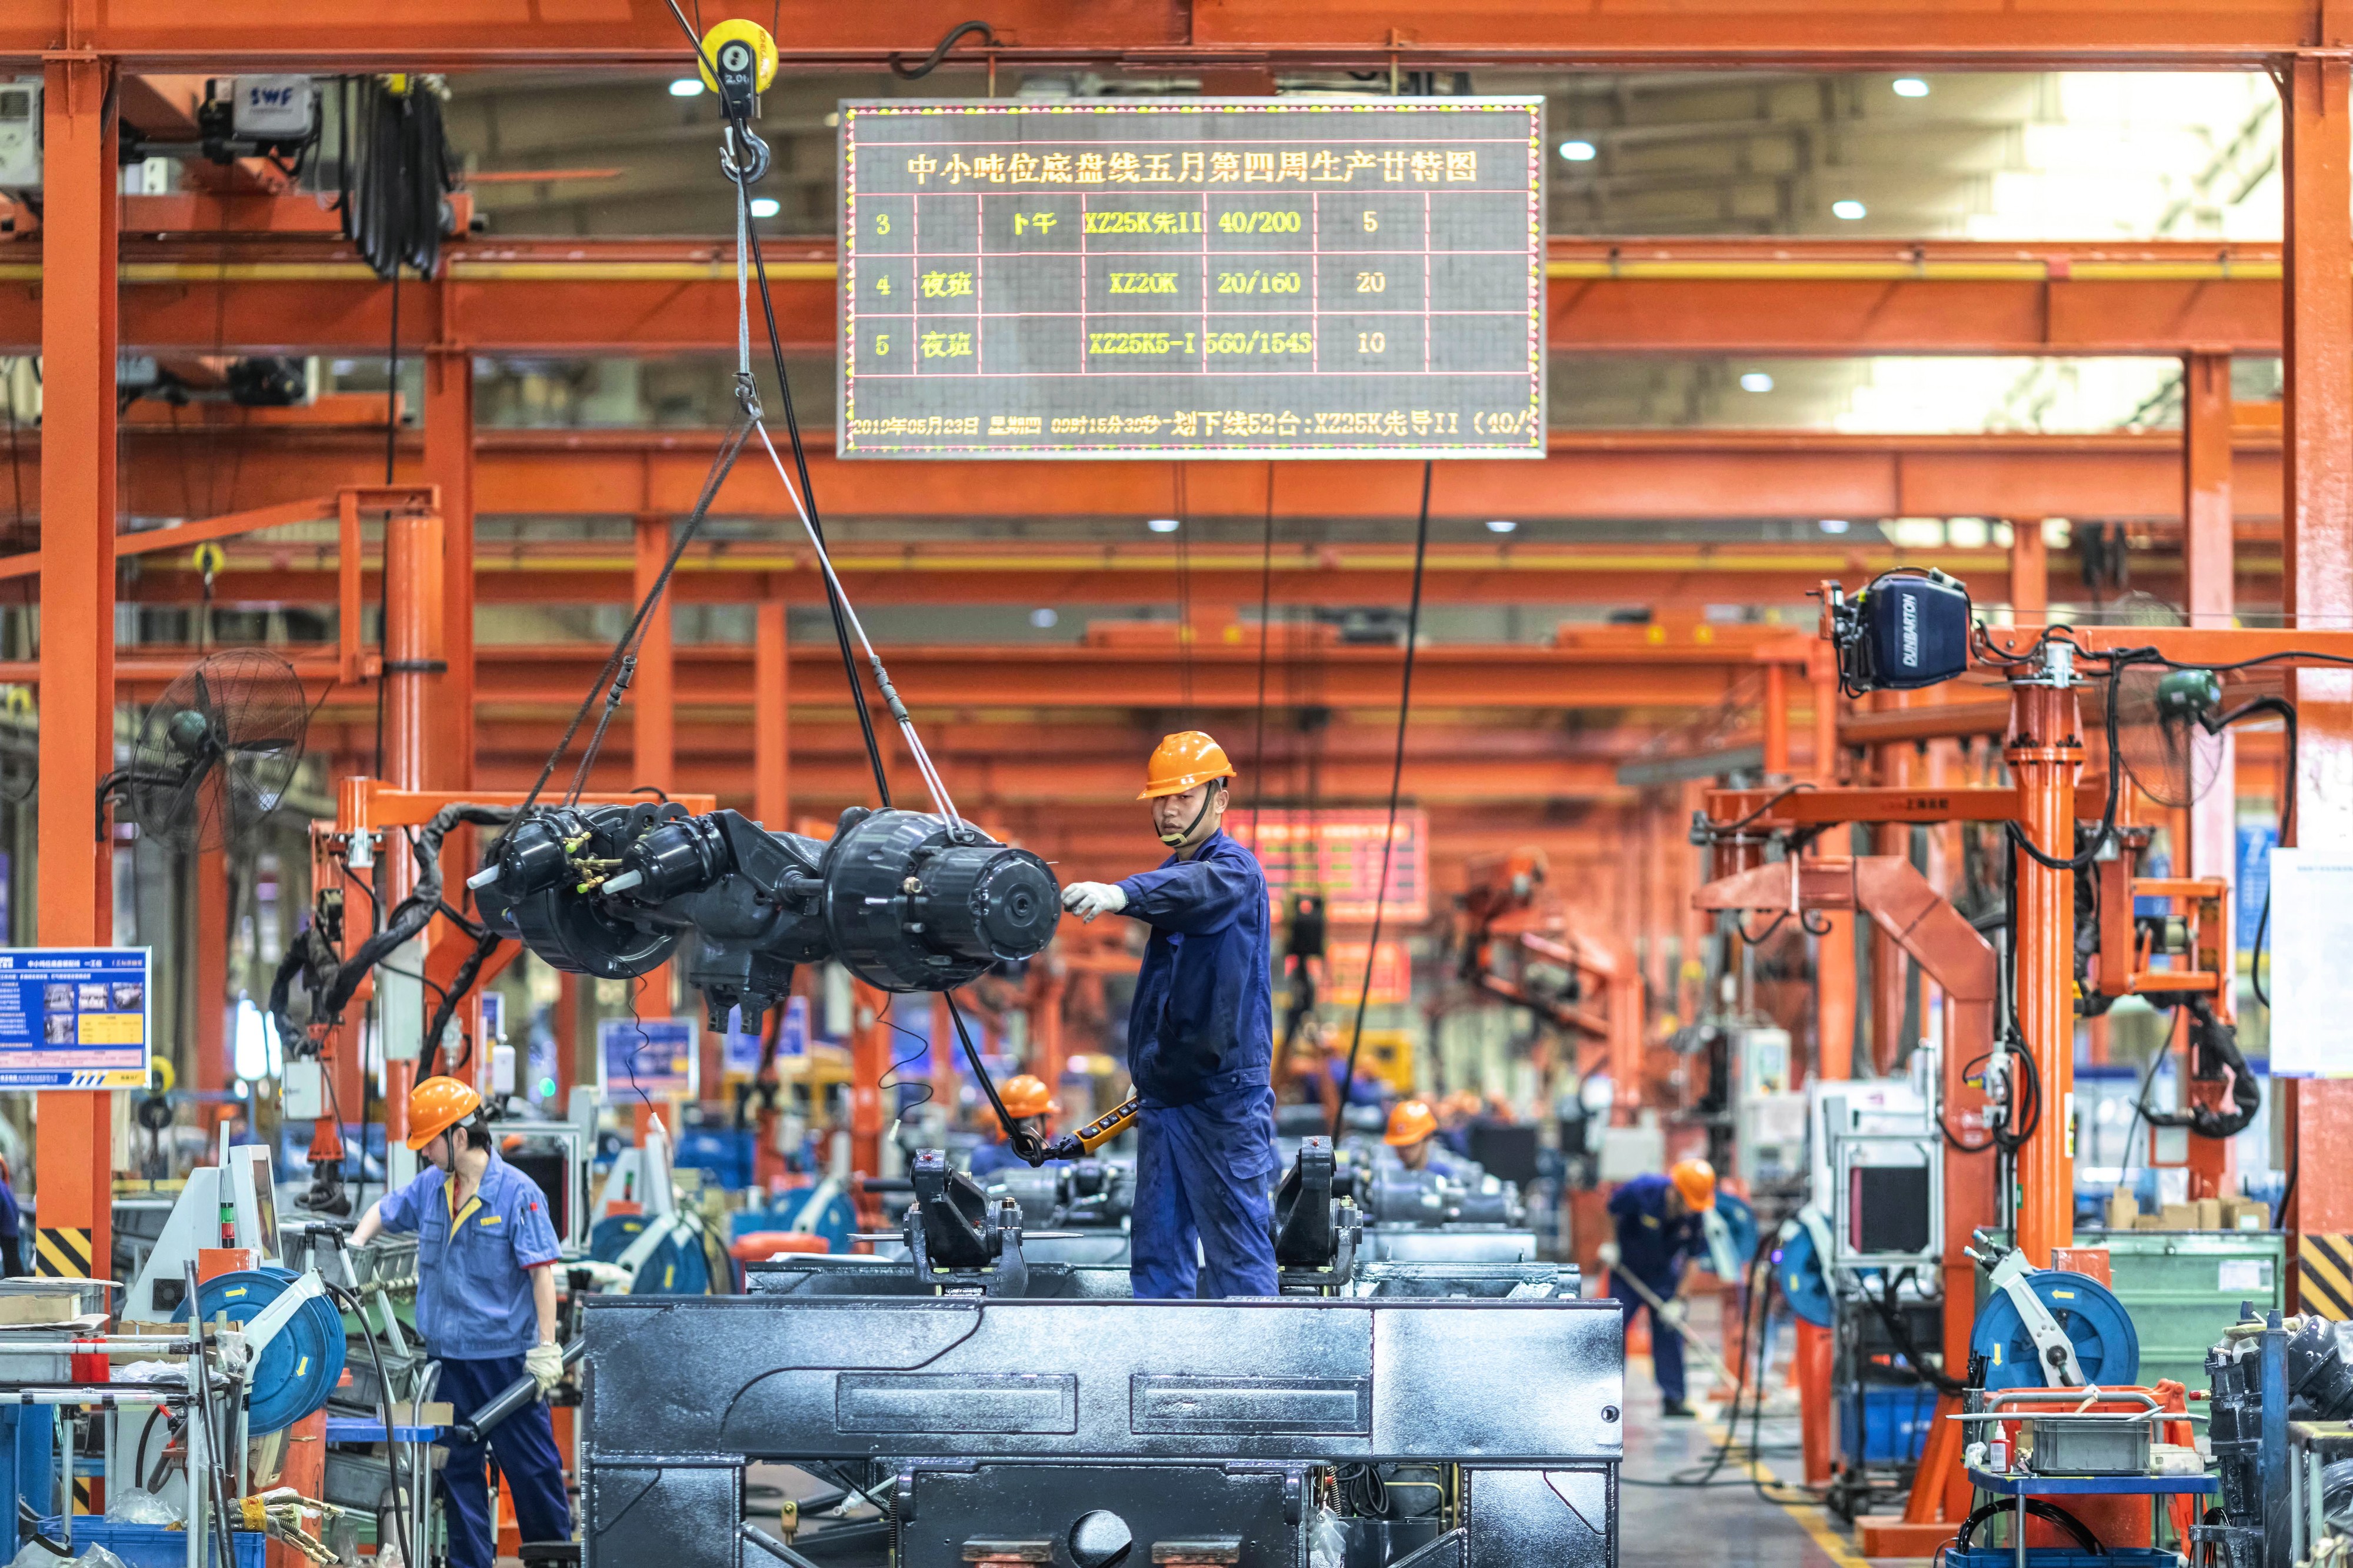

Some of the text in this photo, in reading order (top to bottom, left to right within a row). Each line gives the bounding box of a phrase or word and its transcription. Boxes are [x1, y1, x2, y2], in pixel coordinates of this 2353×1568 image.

[250, 87, 294, 106] SWF
[876, 214, 891, 235] 3
[1218, 211, 1301, 234] 40/200
[1363, 211, 1378, 232] 5
[876, 271, 1386, 298] 4 夜班 XZ20K 20/160 20
[875, 335, 889, 356] 5
[921, 331, 973, 358] 夜班
[1358, 332, 1385, 353] 10
[988, 416, 1042, 436] 星期四
[1902, 593, 1918, 668] DUNBARTON
